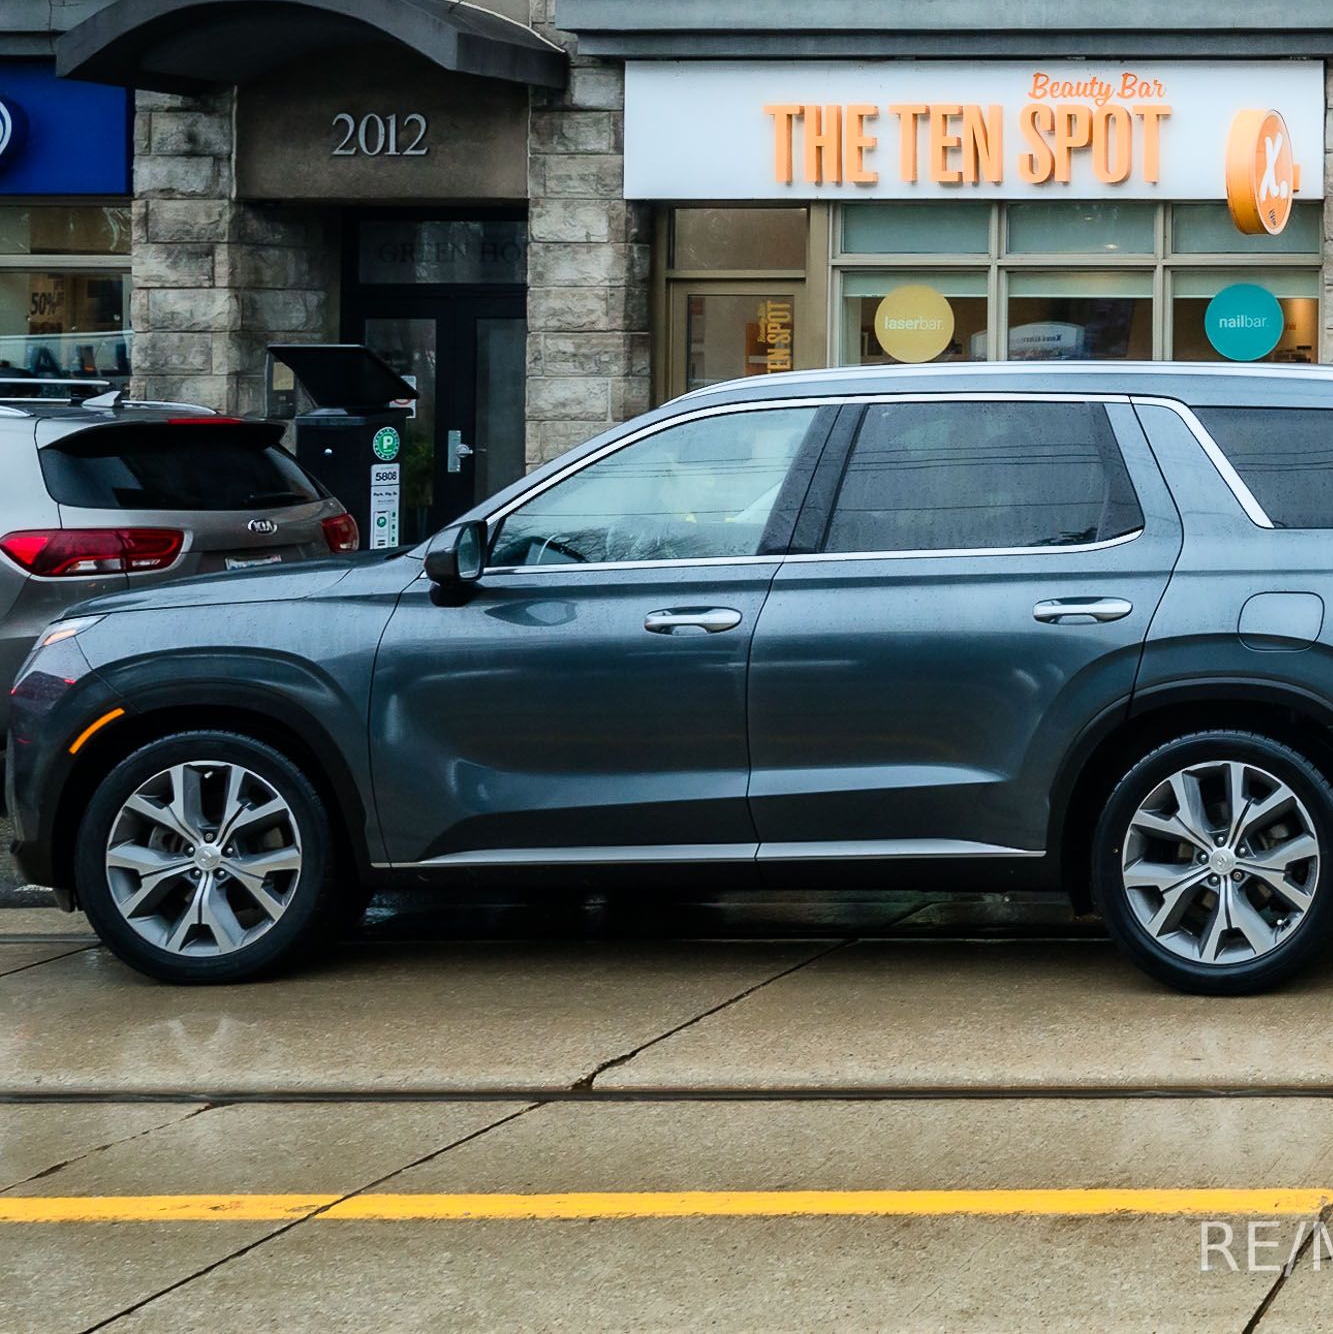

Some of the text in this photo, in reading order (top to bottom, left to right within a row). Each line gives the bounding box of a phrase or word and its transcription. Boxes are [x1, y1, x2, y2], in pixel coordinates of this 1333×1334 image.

[1028, 72, 1166, 107] Beauty Bar
[331, 113, 429, 157] 2012
[763, 103, 1173, 185] THE TEN SPOT
[31, 293, 57, 315] 50%
[767, 300, 791, 374] EN SPOT
[375, 471, 397, 482] 5808
